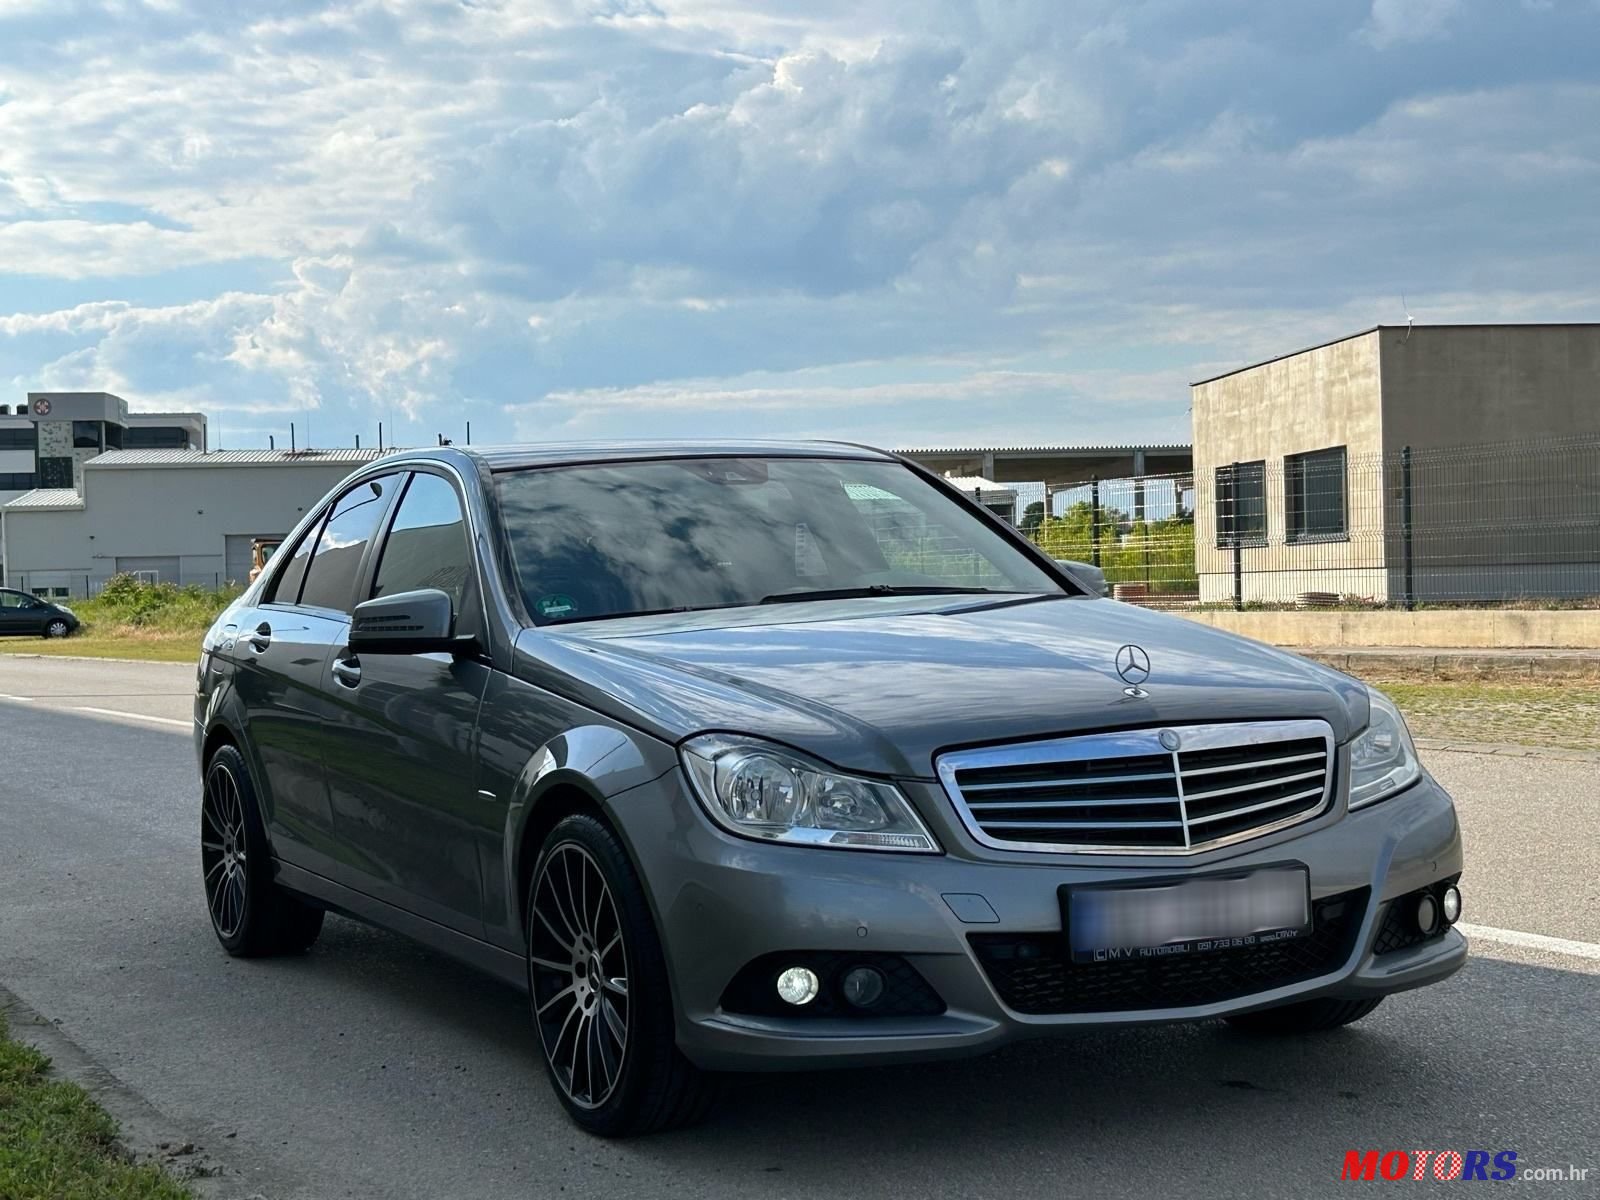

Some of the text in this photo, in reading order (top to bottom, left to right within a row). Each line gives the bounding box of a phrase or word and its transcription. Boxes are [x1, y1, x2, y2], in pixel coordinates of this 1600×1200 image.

[1139, 943, 1189, 957] AUTOMOBILI
[1197, 941, 1212, 950] 091
[1213, 939, 1230, 948] 733
